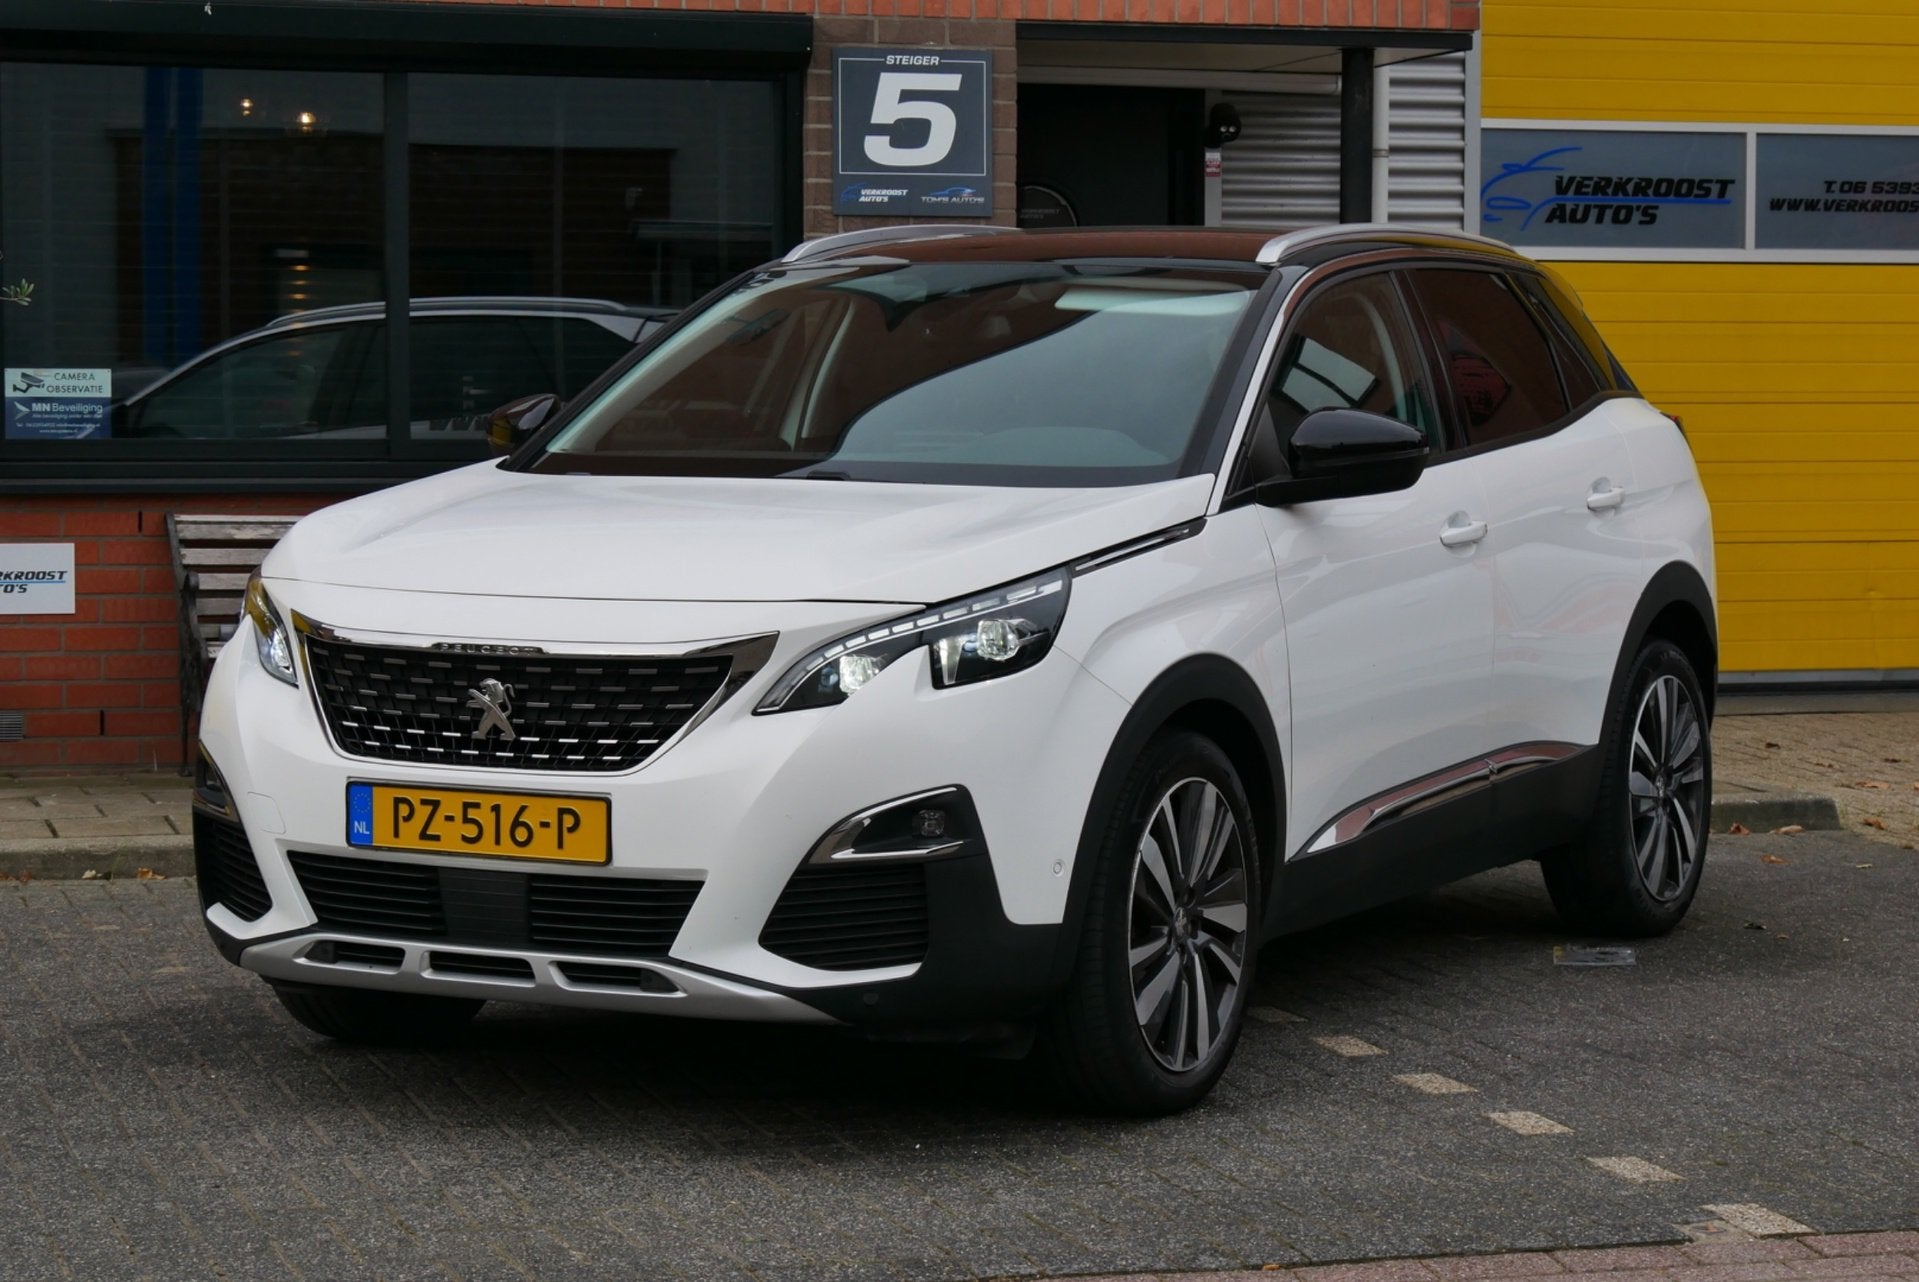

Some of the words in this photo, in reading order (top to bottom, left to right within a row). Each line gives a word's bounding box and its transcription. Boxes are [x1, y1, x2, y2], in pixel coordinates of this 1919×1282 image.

[886, 55, 940, 66] STEIGER
[864, 72, 962, 167] 5
[860, 188, 909, 196] VERKROOST
[1554, 175, 1736, 199] VERKROOST
[858, 195, 889, 203] AUTO'S
[1544, 203, 1660, 226] AUTO'S
[54, 372, 95, 381] CAMERA
[46, 385, 103, 393] OBSERVATIE
[32, 402, 50, 412] MN
[52, 402, 103, 413] Beveiliging
[353, 820, 370, 835] NL
[392, 795, 582, 850] PZ-516-P
